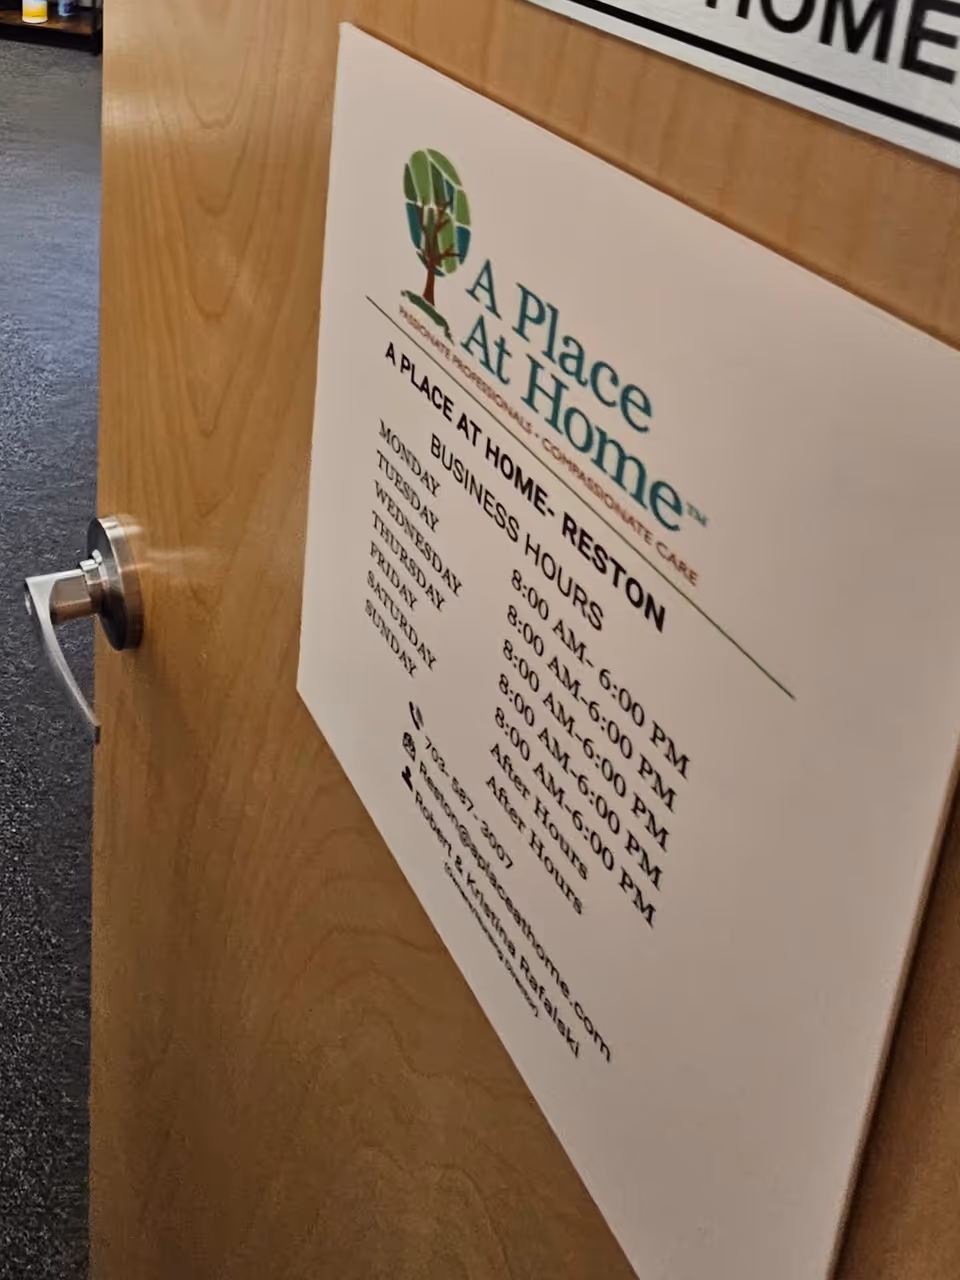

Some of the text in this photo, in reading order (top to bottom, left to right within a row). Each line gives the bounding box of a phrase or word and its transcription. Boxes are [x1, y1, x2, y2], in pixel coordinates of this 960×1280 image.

[385, 343, 666, 633] A PLACE AT HOME- RESTON
[451, 354, 533, 435] PROFESSIONALS
[541, 437, 653, 545] COMPASSIONATE
[656, 541, 697, 586] CARE
[460, 315, 512, 385] At
[521, 354, 683, 532] Home
[465, 259, 654, 433] A Place
[374, 479, 462, 598] WEDNESDAY
[503, 639, 539, 692] 8:00
[631, 792, 670, 852] PM
[376, 449, 439, 533] TUESDAY
[507, 605, 544, 656] 8:00
[637, 754, 677, 813] PM
[378, 419, 440, 498] MONDAY
[511, 569, 549, 620] 8:00
[599, 669, 645, 727] 6:00
[650, 721, 690, 779] PM
[430, 433, 603, 631] BUSINESS HOURS
[365, 599, 416, 678] SUNDAY
[486, 775, 526, 833] After
[529, 833, 583, 915] Hours
[367, 570, 438, 671] SATURDAY
[491, 743, 530, 799] After
[534, 800, 589, 880] Hours
[370, 540, 417, 612] FRIDAY
[495, 707, 530, 761] 8:00
[618, 867, 657, 928] PM
[372, 510, 447, 613] THURSDAY
[499, 674, 534, 726] 8:00
[624, 830, 663, 891] PM
[467, 872, 516, 959] Kristina
[520, 955, 580, 1059] Rafalski
